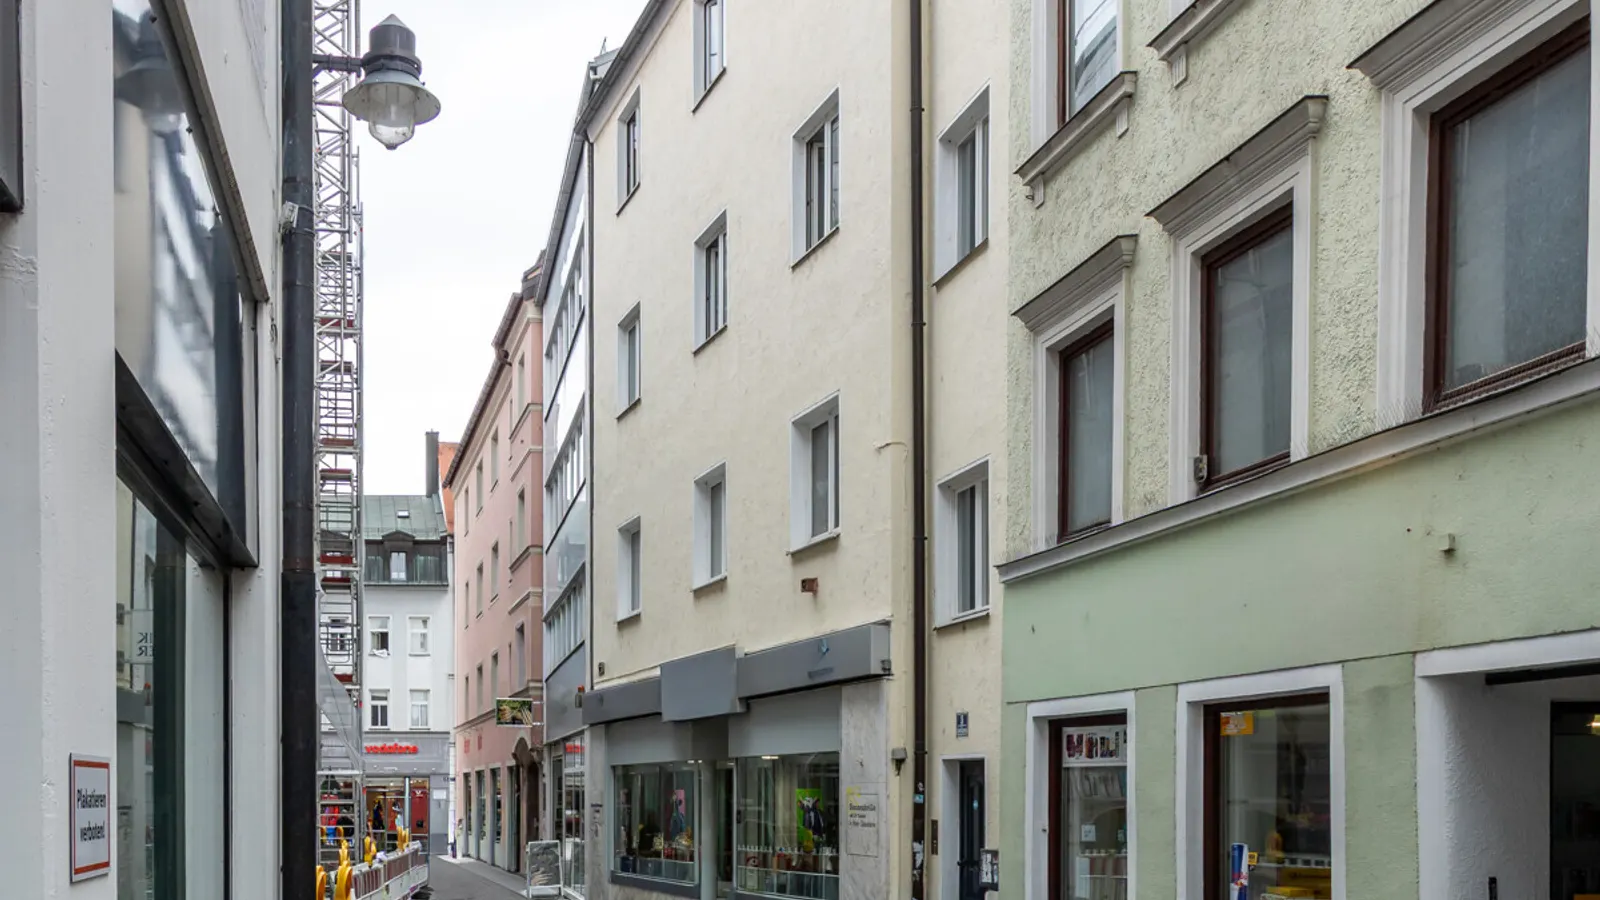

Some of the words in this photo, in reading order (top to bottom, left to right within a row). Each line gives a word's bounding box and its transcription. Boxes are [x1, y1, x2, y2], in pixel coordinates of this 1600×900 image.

[365, 743, 418, 754] vodafone
[77, 788, 106, 809] Plakatieren
[80, 820, 105, 841] verboten!
